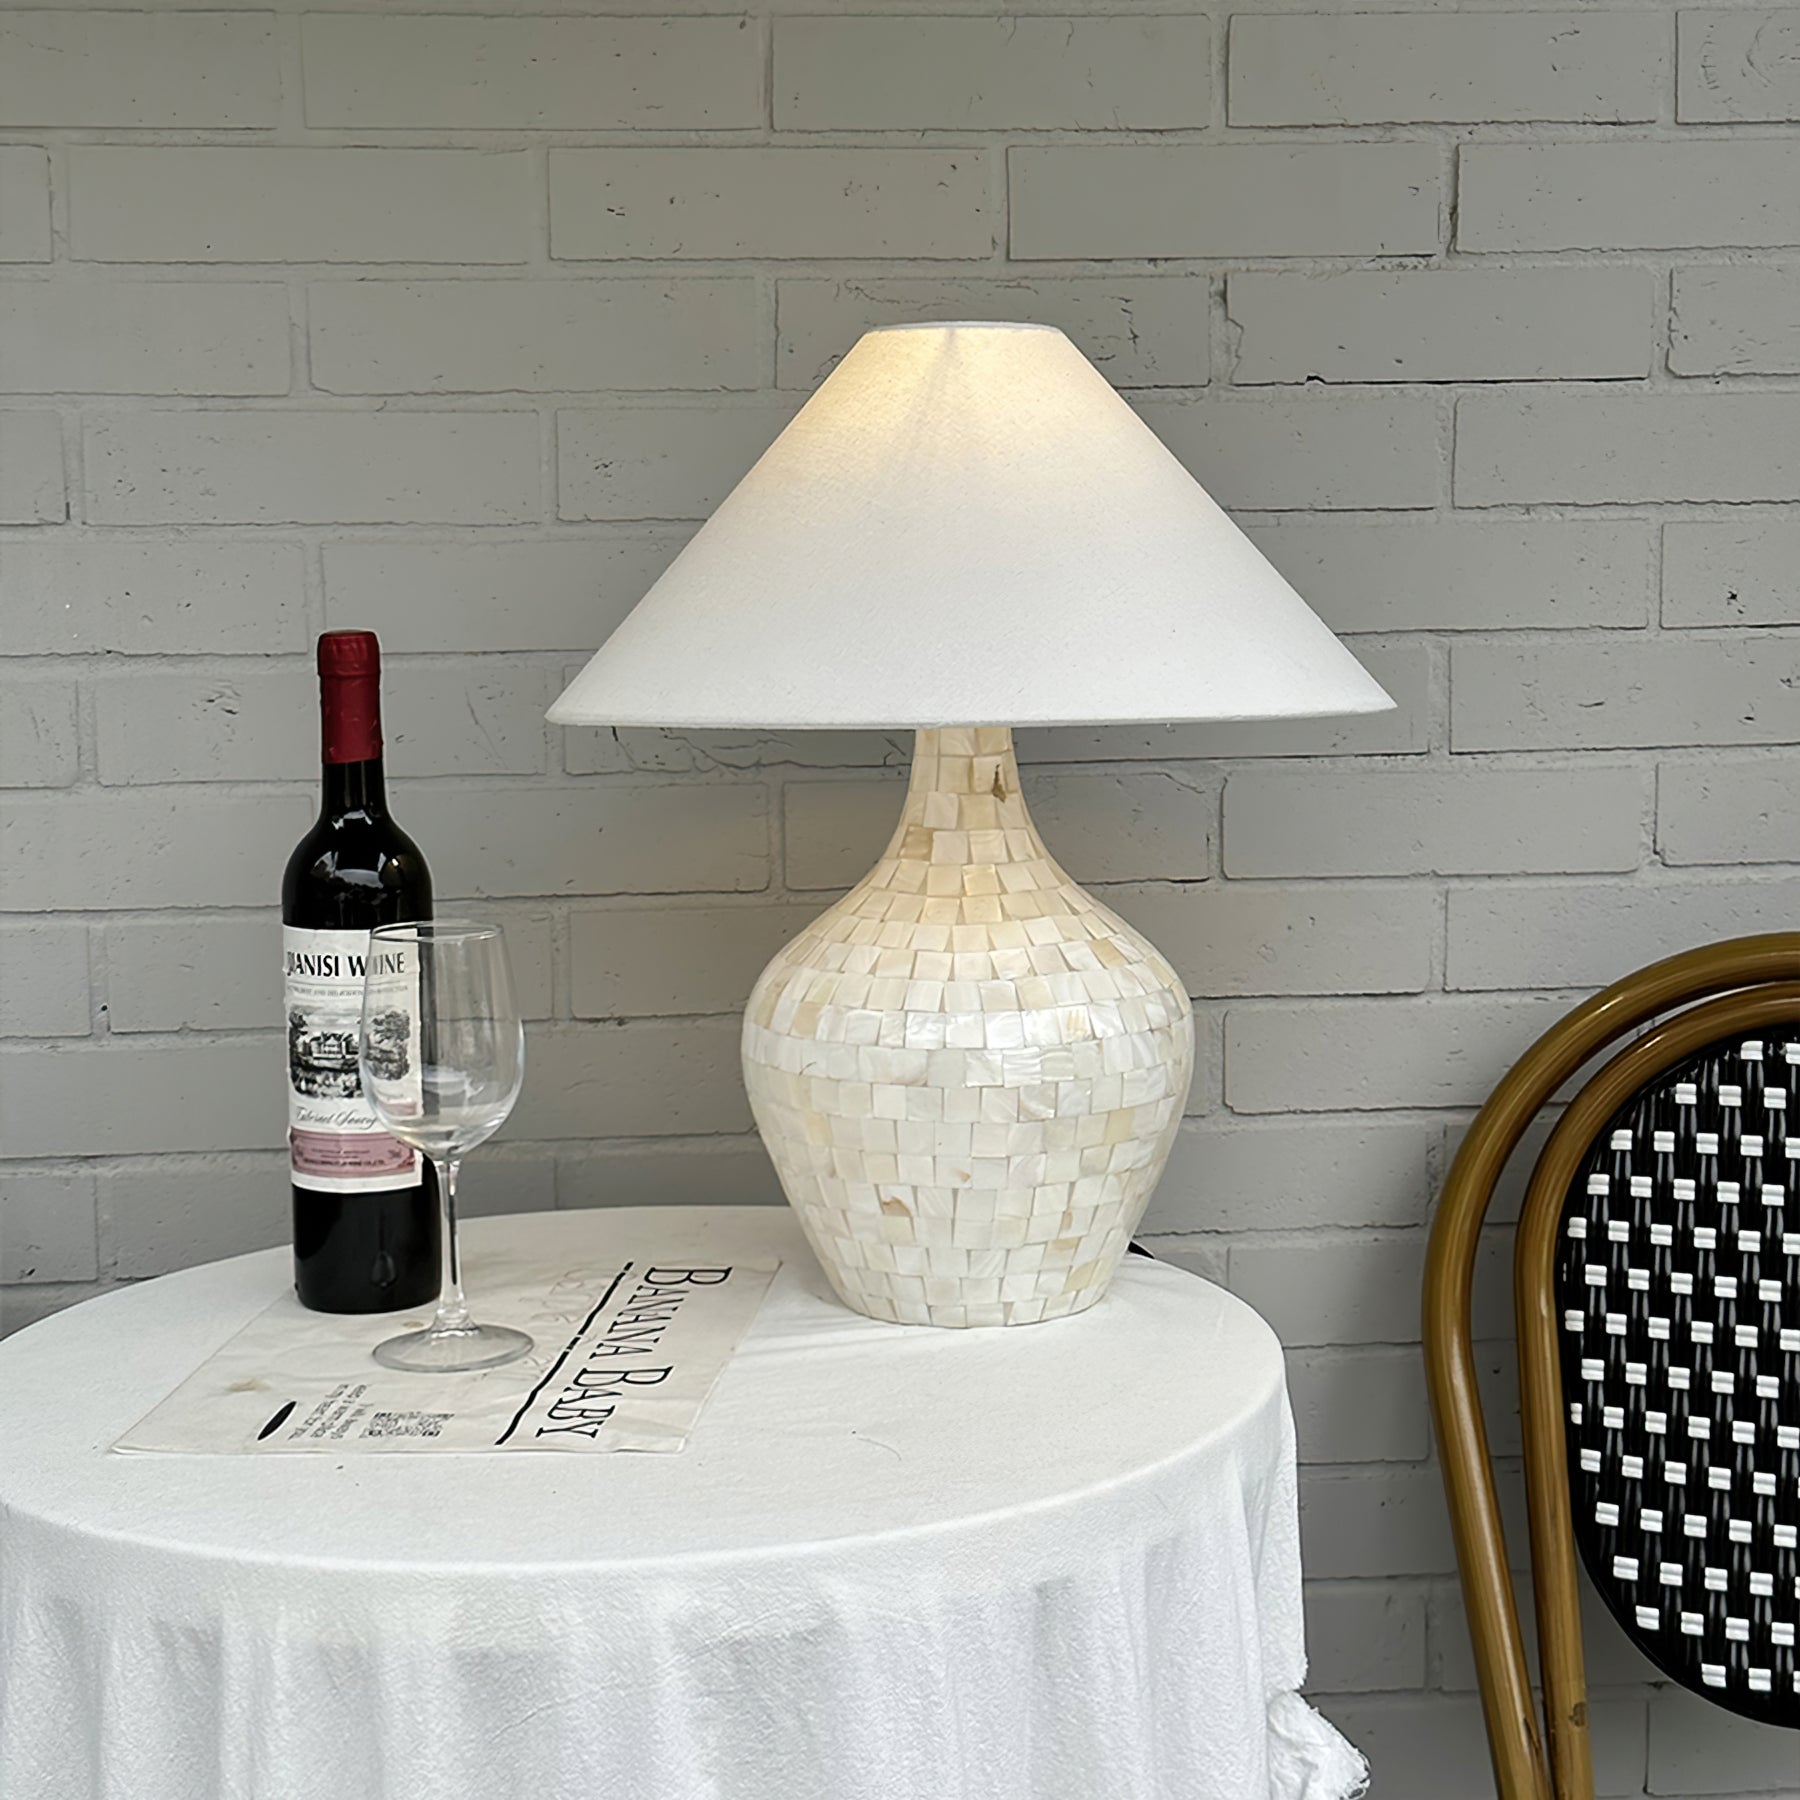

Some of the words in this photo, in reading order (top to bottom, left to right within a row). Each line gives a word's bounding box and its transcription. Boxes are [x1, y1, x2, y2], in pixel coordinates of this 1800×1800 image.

[347, 952, 405, 977] WINE
[589, 1266, 733, 1360] BANANA
[535, 1365, 674, 1438] BABY
